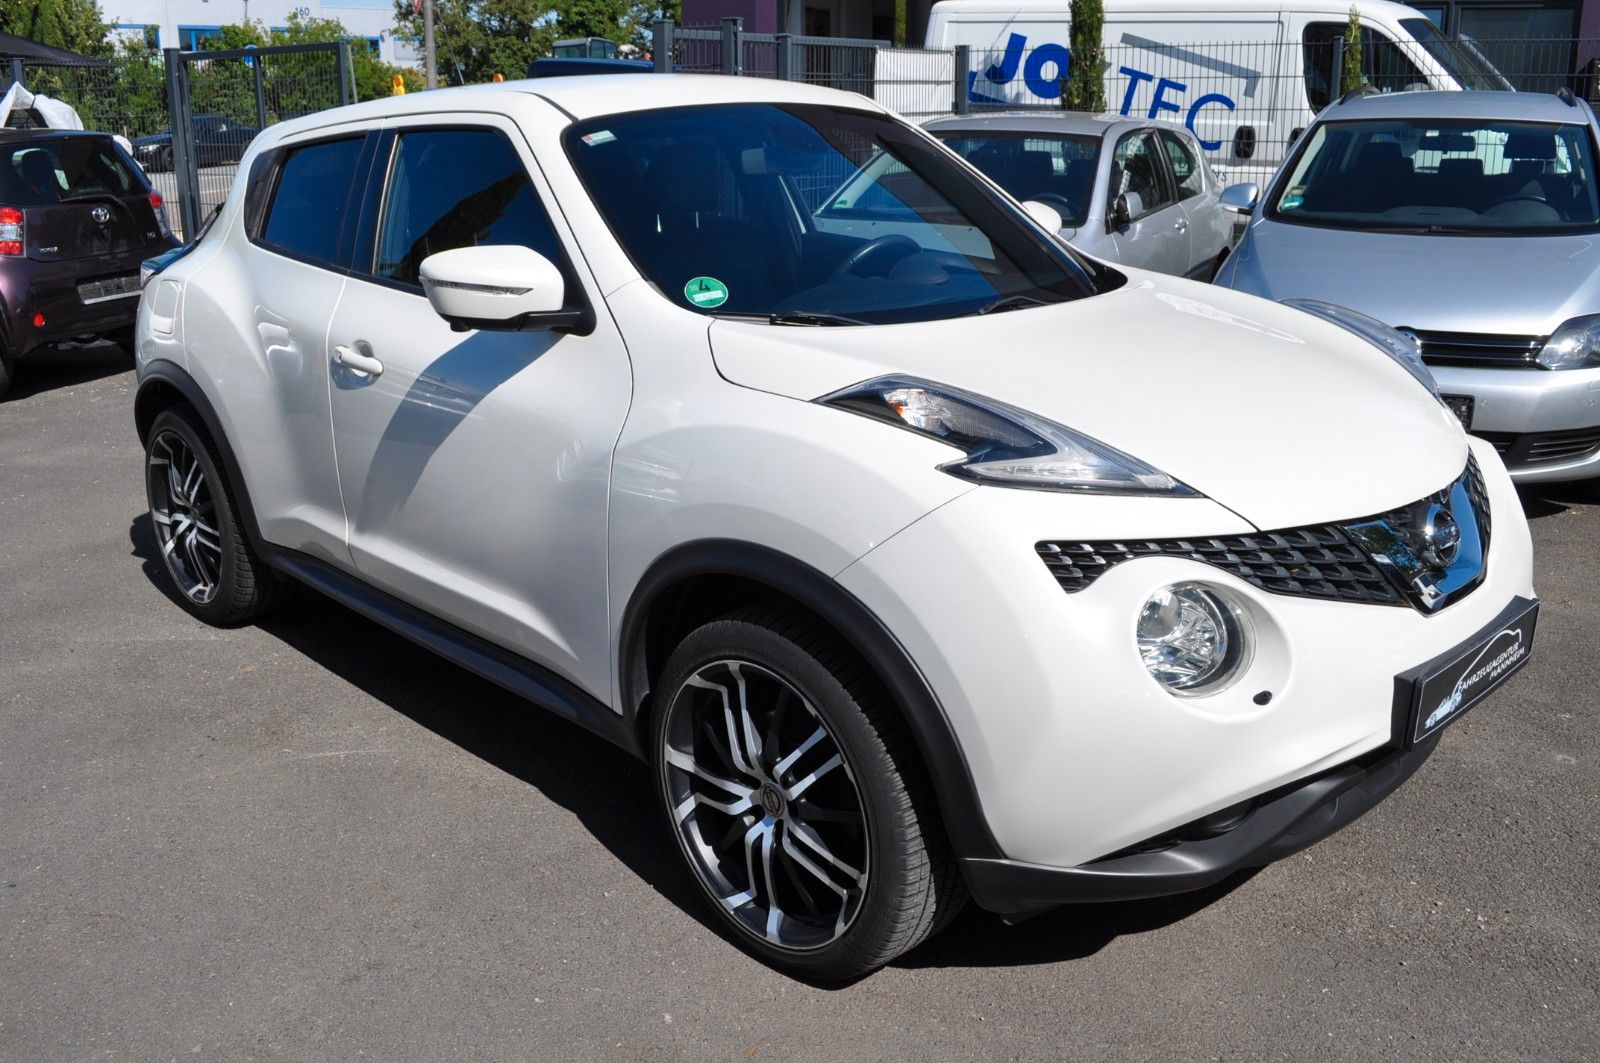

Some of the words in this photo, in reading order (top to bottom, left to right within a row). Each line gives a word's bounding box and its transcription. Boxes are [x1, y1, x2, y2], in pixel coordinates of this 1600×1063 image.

[699, 279, 711, 292] 4
[1457, 641, 1519, 692] FAHRZEUGAGENTUR
[1489, 645, 1525, 681] MANNHEIM
